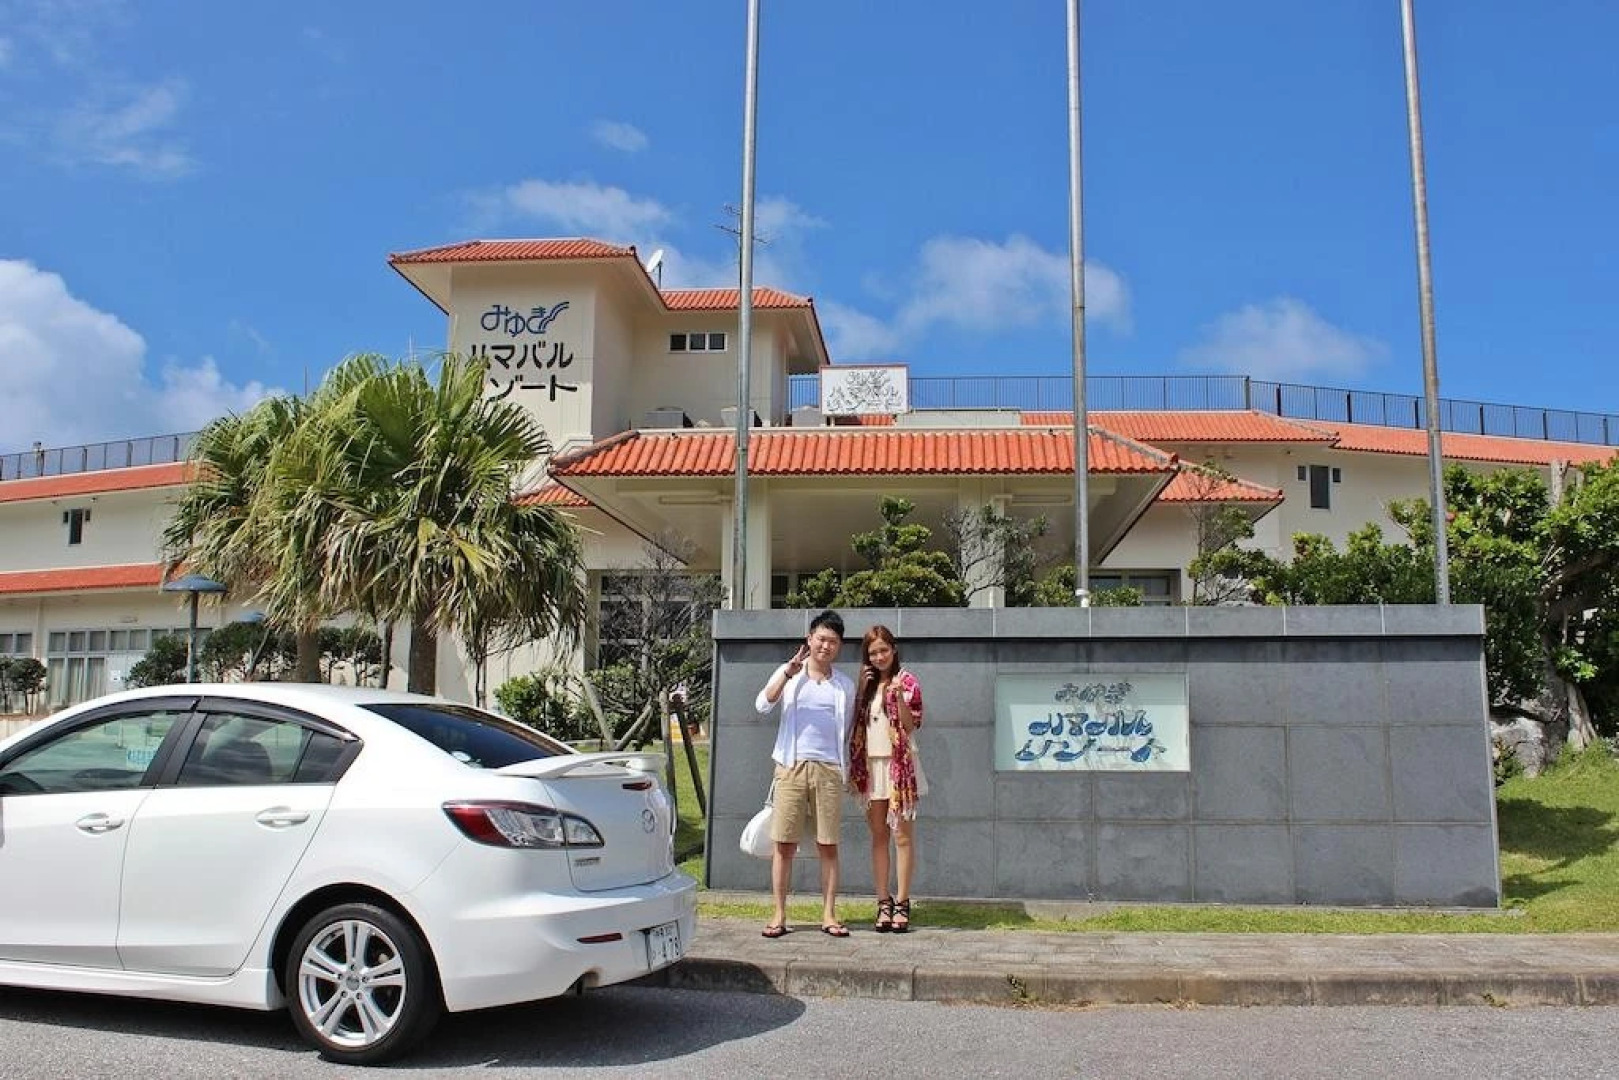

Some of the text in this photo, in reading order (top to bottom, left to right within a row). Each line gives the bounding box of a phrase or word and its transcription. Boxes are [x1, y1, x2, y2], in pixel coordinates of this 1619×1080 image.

[480, 301, 570, 337] みゆき
[486, 374, 578, 402] ゾート
